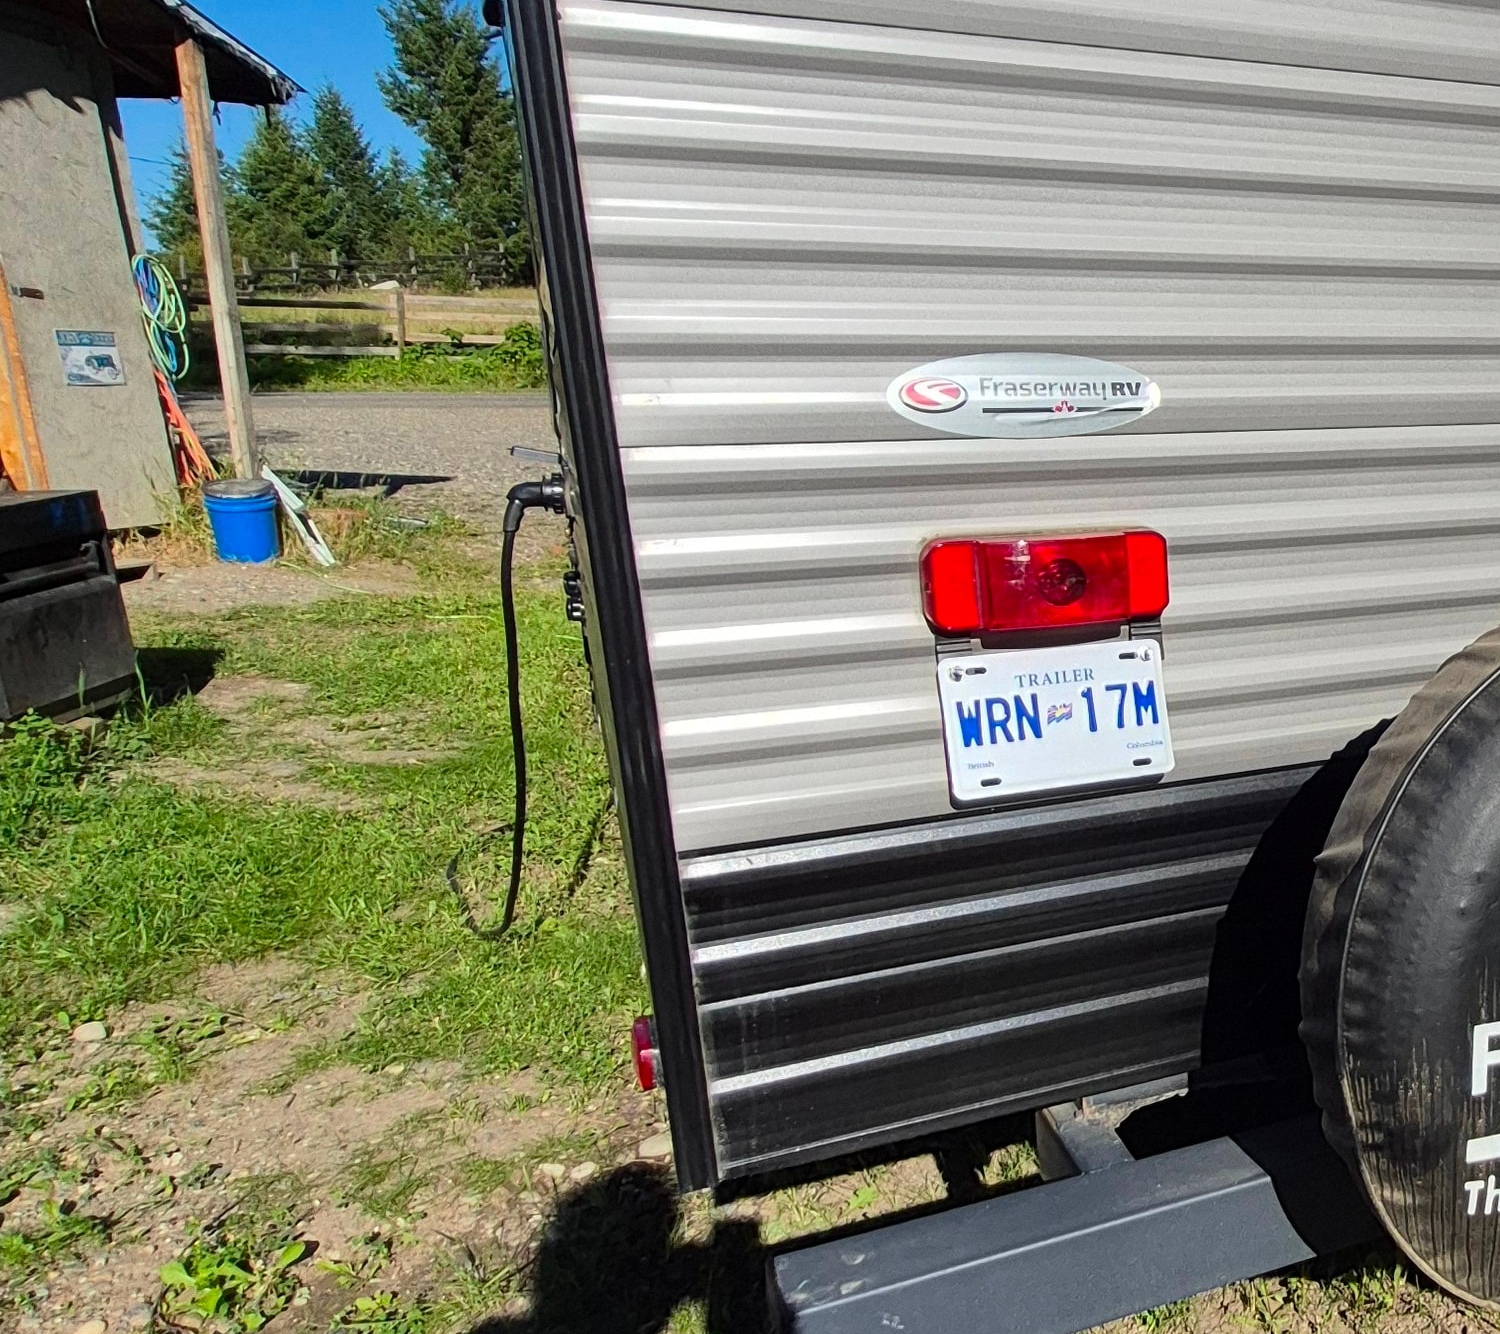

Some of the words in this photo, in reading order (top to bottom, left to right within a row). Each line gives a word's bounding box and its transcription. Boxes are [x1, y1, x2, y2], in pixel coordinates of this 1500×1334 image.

[979, 377, 1107, 400] Fraserway
[1111, 382, 1142, 396] RV
[1014, 668, 1096, 688] TRAILER
[955, 693, 1043, 748] WRN
[1079, 679, 1160, 733] 17M
